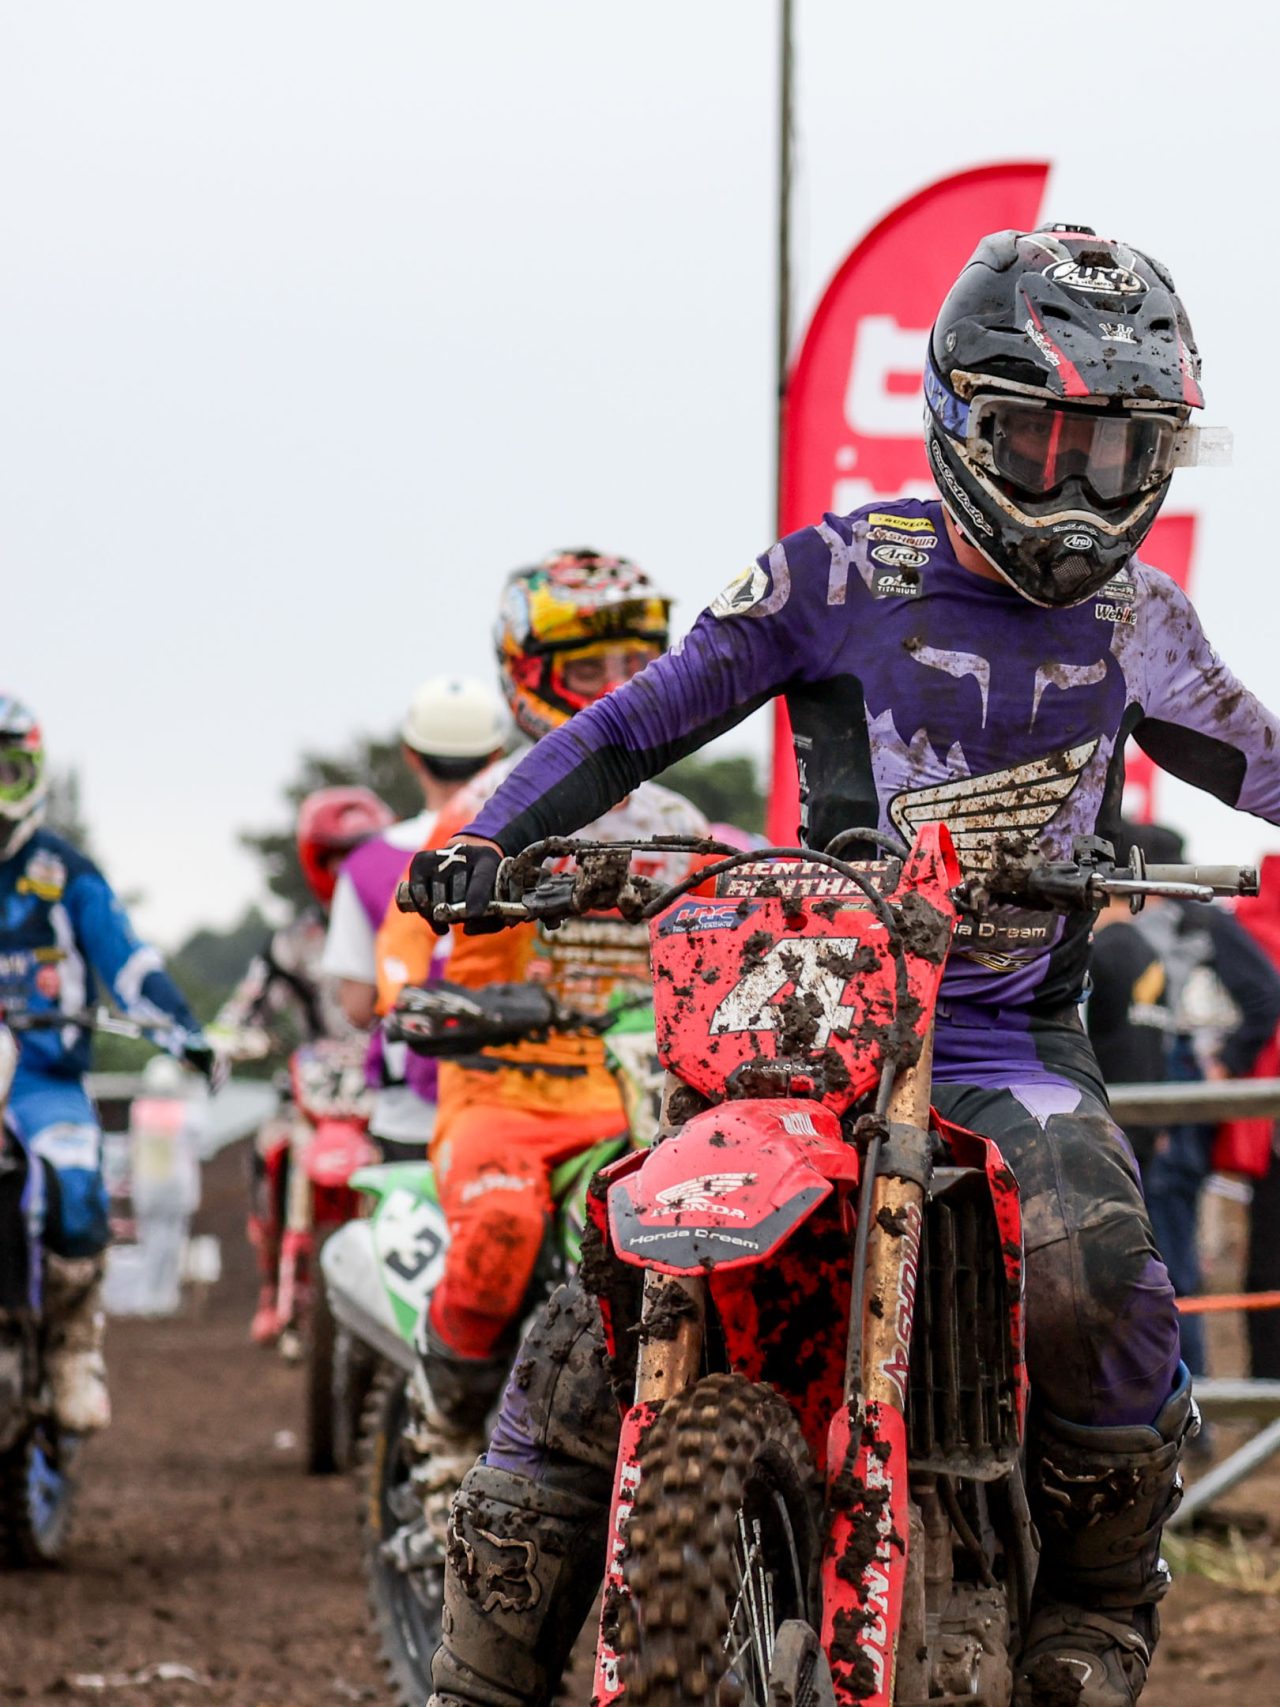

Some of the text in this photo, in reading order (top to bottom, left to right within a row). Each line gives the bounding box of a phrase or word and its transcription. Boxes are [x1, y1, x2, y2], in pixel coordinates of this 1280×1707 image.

[889, 533, 936, 547] SHOWA
[1065, 535, 1091, 546] Arai
[879, 548, 920, 563] Arai
[876, 585, 918, 595] TITANIUM
[708, 937, 859, 1054] 4
[650, 1203, 750, 1221] HONDA
[629, 1228, 760, 1251] Honda Dream
